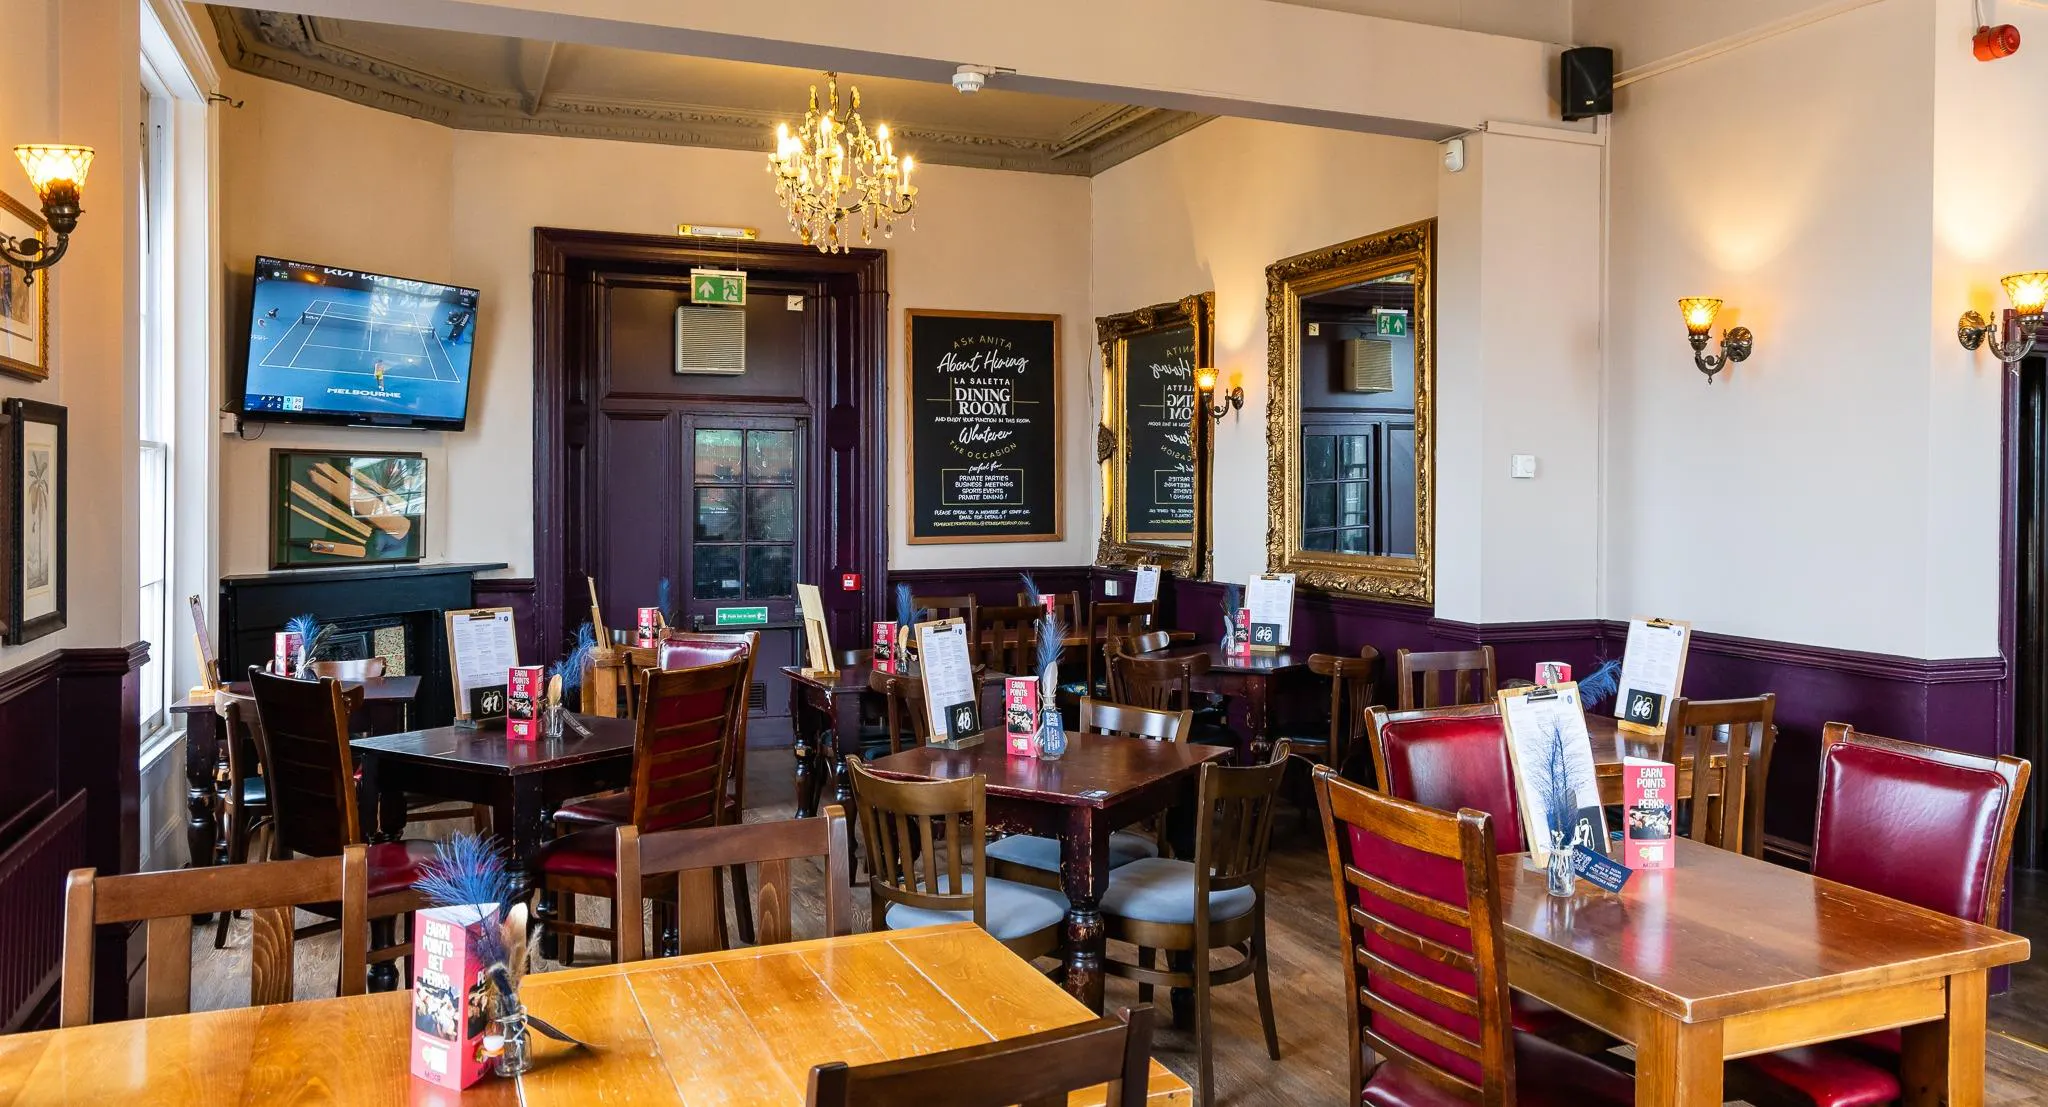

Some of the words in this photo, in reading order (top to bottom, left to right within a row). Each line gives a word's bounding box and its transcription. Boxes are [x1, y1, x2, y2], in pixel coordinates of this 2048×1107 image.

[953, 336, 974, 349] ASK
[979, 335, 1013, 350] ANITA
[936, 351, 982, 373] About
[983, 349, 1029, 373] Hiring
[954, 377, 966, 385] LA
[969, 378, 1011, 386] SALETTA
[326, 387, 401, 399] MELBOURNE
[955, 387, 1011, 402] DINING
[958, 401, 1007, 416] ROOM
[959, 423, 1013, 444] Whatever
[949, 440, 964, 454] THE
[967, 442, 1018, 460] OCCASION
[990, 461, 1003, 472] for
[1256, 629, 1272, 642] 45
[514, 669, 528, 678] EARN
[512, 677, 530, 685] POINTS
[1011, 681, 1025, 689] EARN
[515, 684, 525, 692] GET
[1009, 689, 1028, 697] POINTS
[512, 691, 529, 699] PERKS
[1013, 696, 1023, 704] GET
[1010, 703, 1026, 712] PERKS
[1633, 702, 1651, 718] 46
[957, 711, 970, 730] 48
[1640, 767, 1663, 778] EARN
[1636, 778, 1666, 789] POINTS
[1643, 788, 1660, 799] GET
[1638, 798, 1665, 809] PERKS
[425, 920, 451, 941] EARN
[422, 935, 454, 959] POINTS
[428, 953, 445, 973] GET
[422, 967, 450, 989] PERKS
